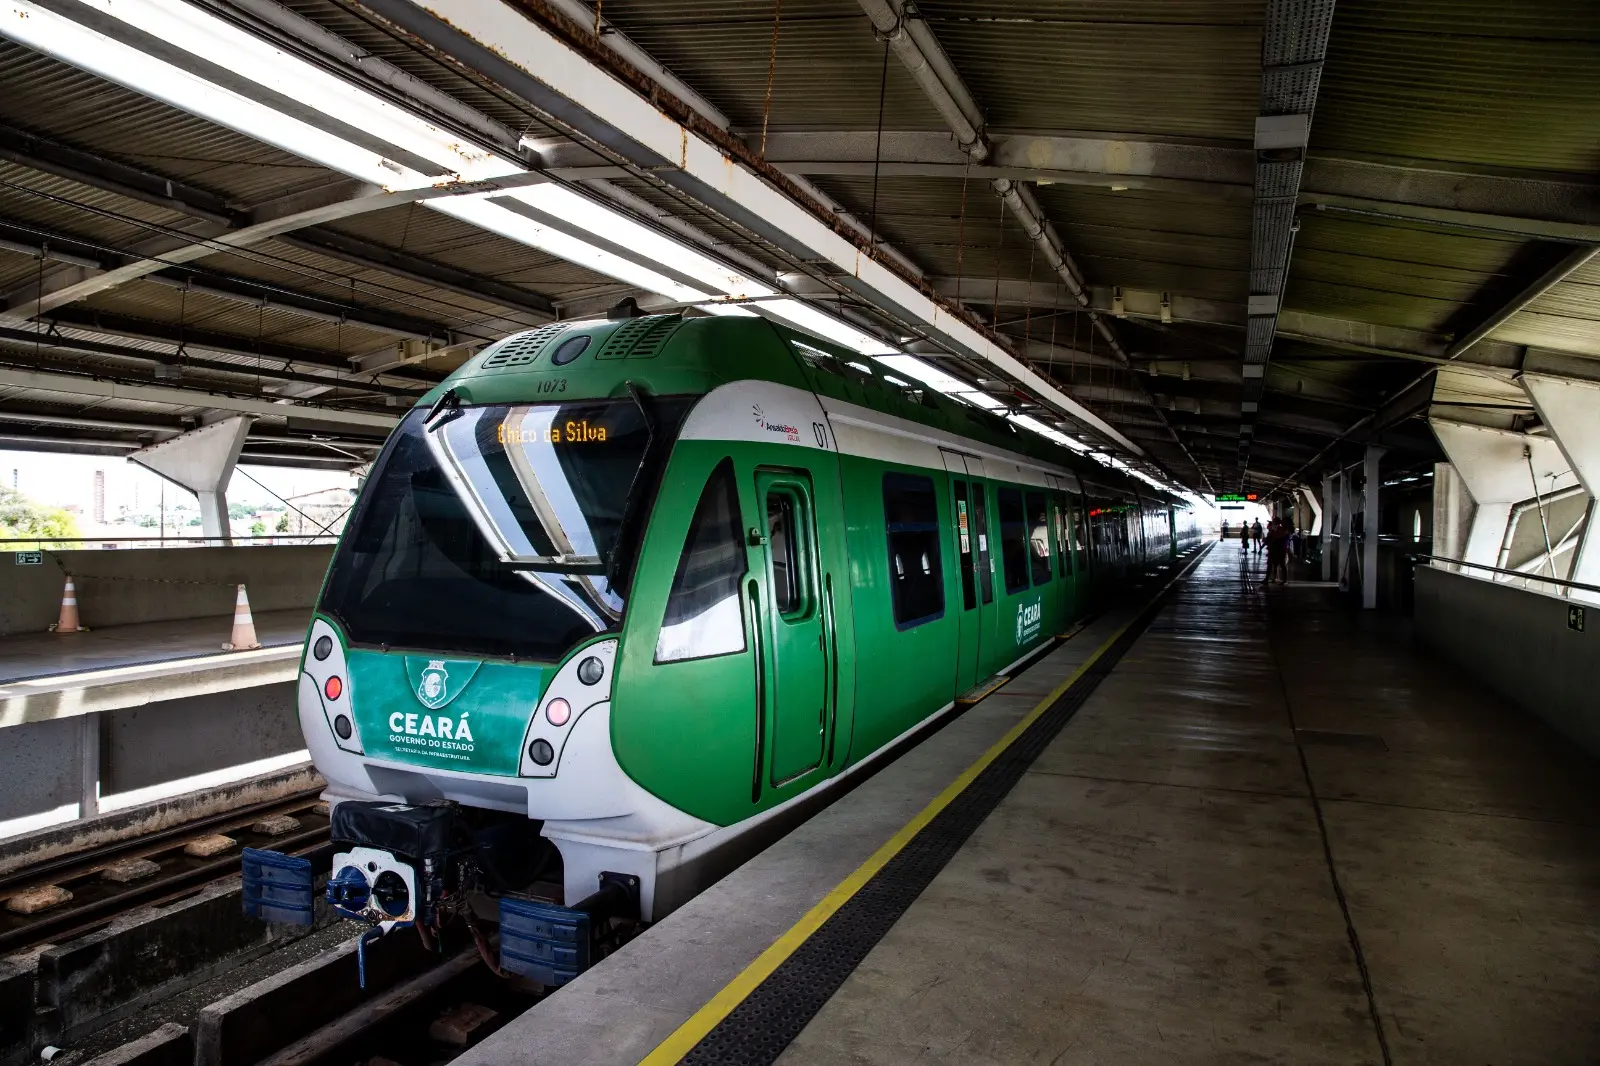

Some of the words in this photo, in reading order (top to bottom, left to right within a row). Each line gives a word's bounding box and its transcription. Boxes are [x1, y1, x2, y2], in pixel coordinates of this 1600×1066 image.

[537, 379, 567, 393] 1073
[498, 424, 537, 443] Chico
[544, 422, 561, 442] da
[566, 421, 606, 442] Silva
[812, 422, 829, 449] 07
[1023, 595, 1041, 627] CEARÁ
[389, 711, 474, 742] CEARÁ
[389, 734, 427, 746] GOVERNO
[428, 740, 441, 748] DO
[442, 741, 475, 752] ESTADO
